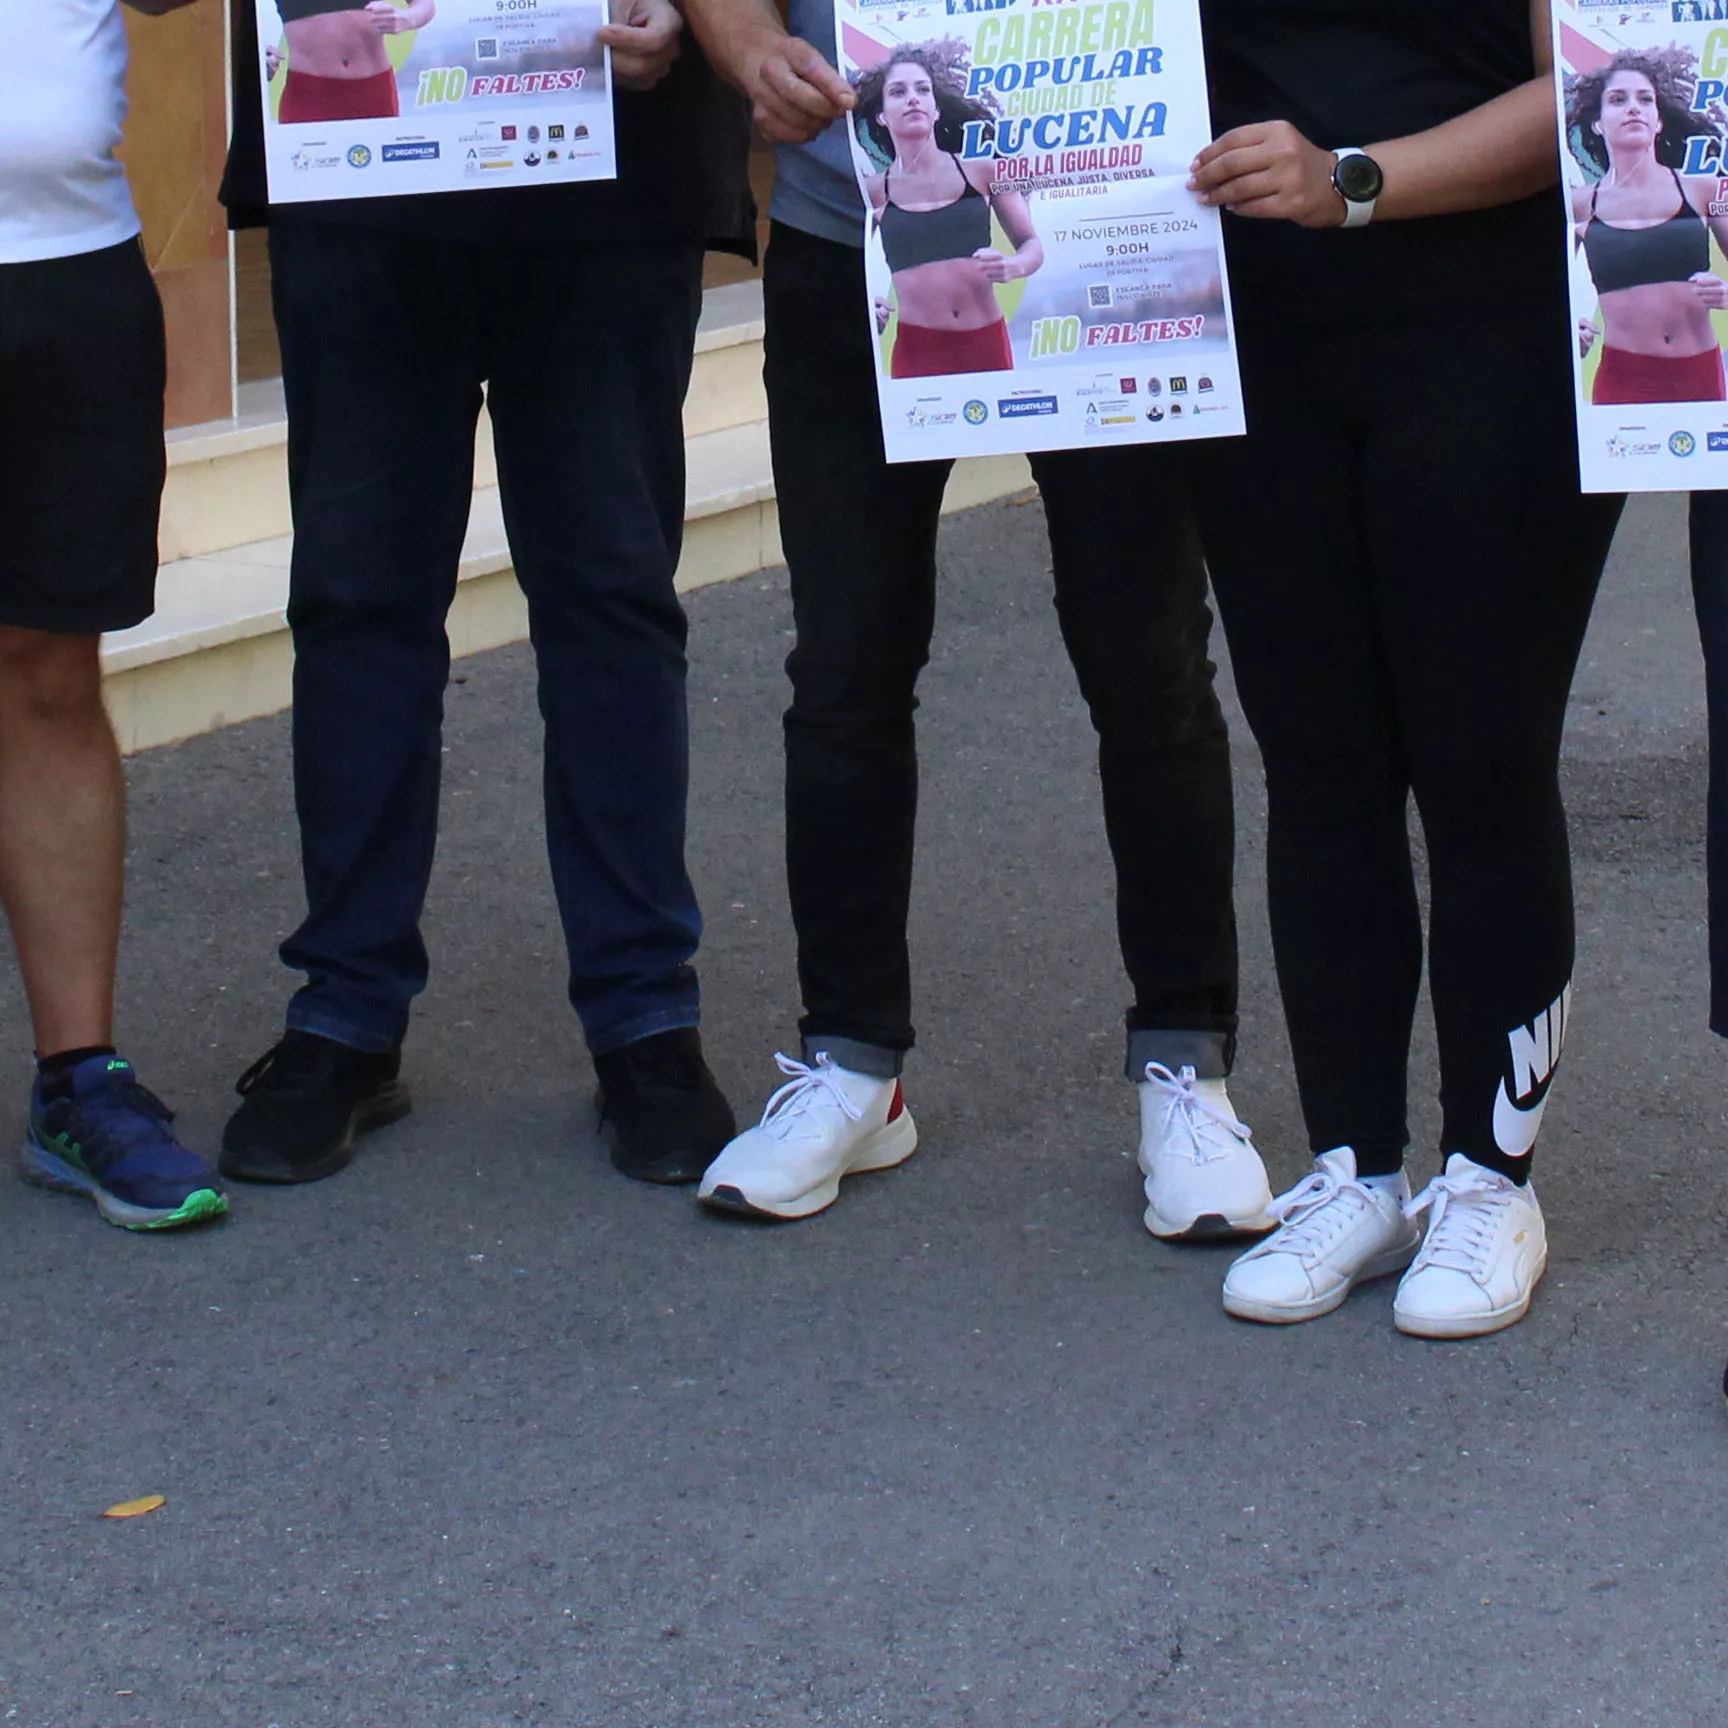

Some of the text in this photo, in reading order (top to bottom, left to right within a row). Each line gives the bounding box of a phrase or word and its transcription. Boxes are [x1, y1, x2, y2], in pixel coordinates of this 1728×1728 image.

[967, 47, 1164, 96] POPULAR
[417, 68, 586, 106] ¡NO FALTES!
[1007, 81, 1117, 117] CIUDAD DE
[962, 101, 1168, 159] LUCENA
[394, 146, 436, 158] DECATHLON
[995, 143, 1143, 181] POR LA IGUALDAD
[991, 183, 1010, 193] POR
[1013, 181, 1032, 192] UNA
[1035, 178, 1073, 189] LUCENA
[1114, 169, 1156, 182] DIVERSA
[1040, 186, 1109, 200] E IGUALITARIA
[1054, 219, 1199, 242] 17 NOVIEMBRE 2024
[1106, 242, 1150, 256] 9:00H
[1031, 316, 1204, 358] ¡NO FALTES!
[1011, 400, 1054, 412] DECATHLON
